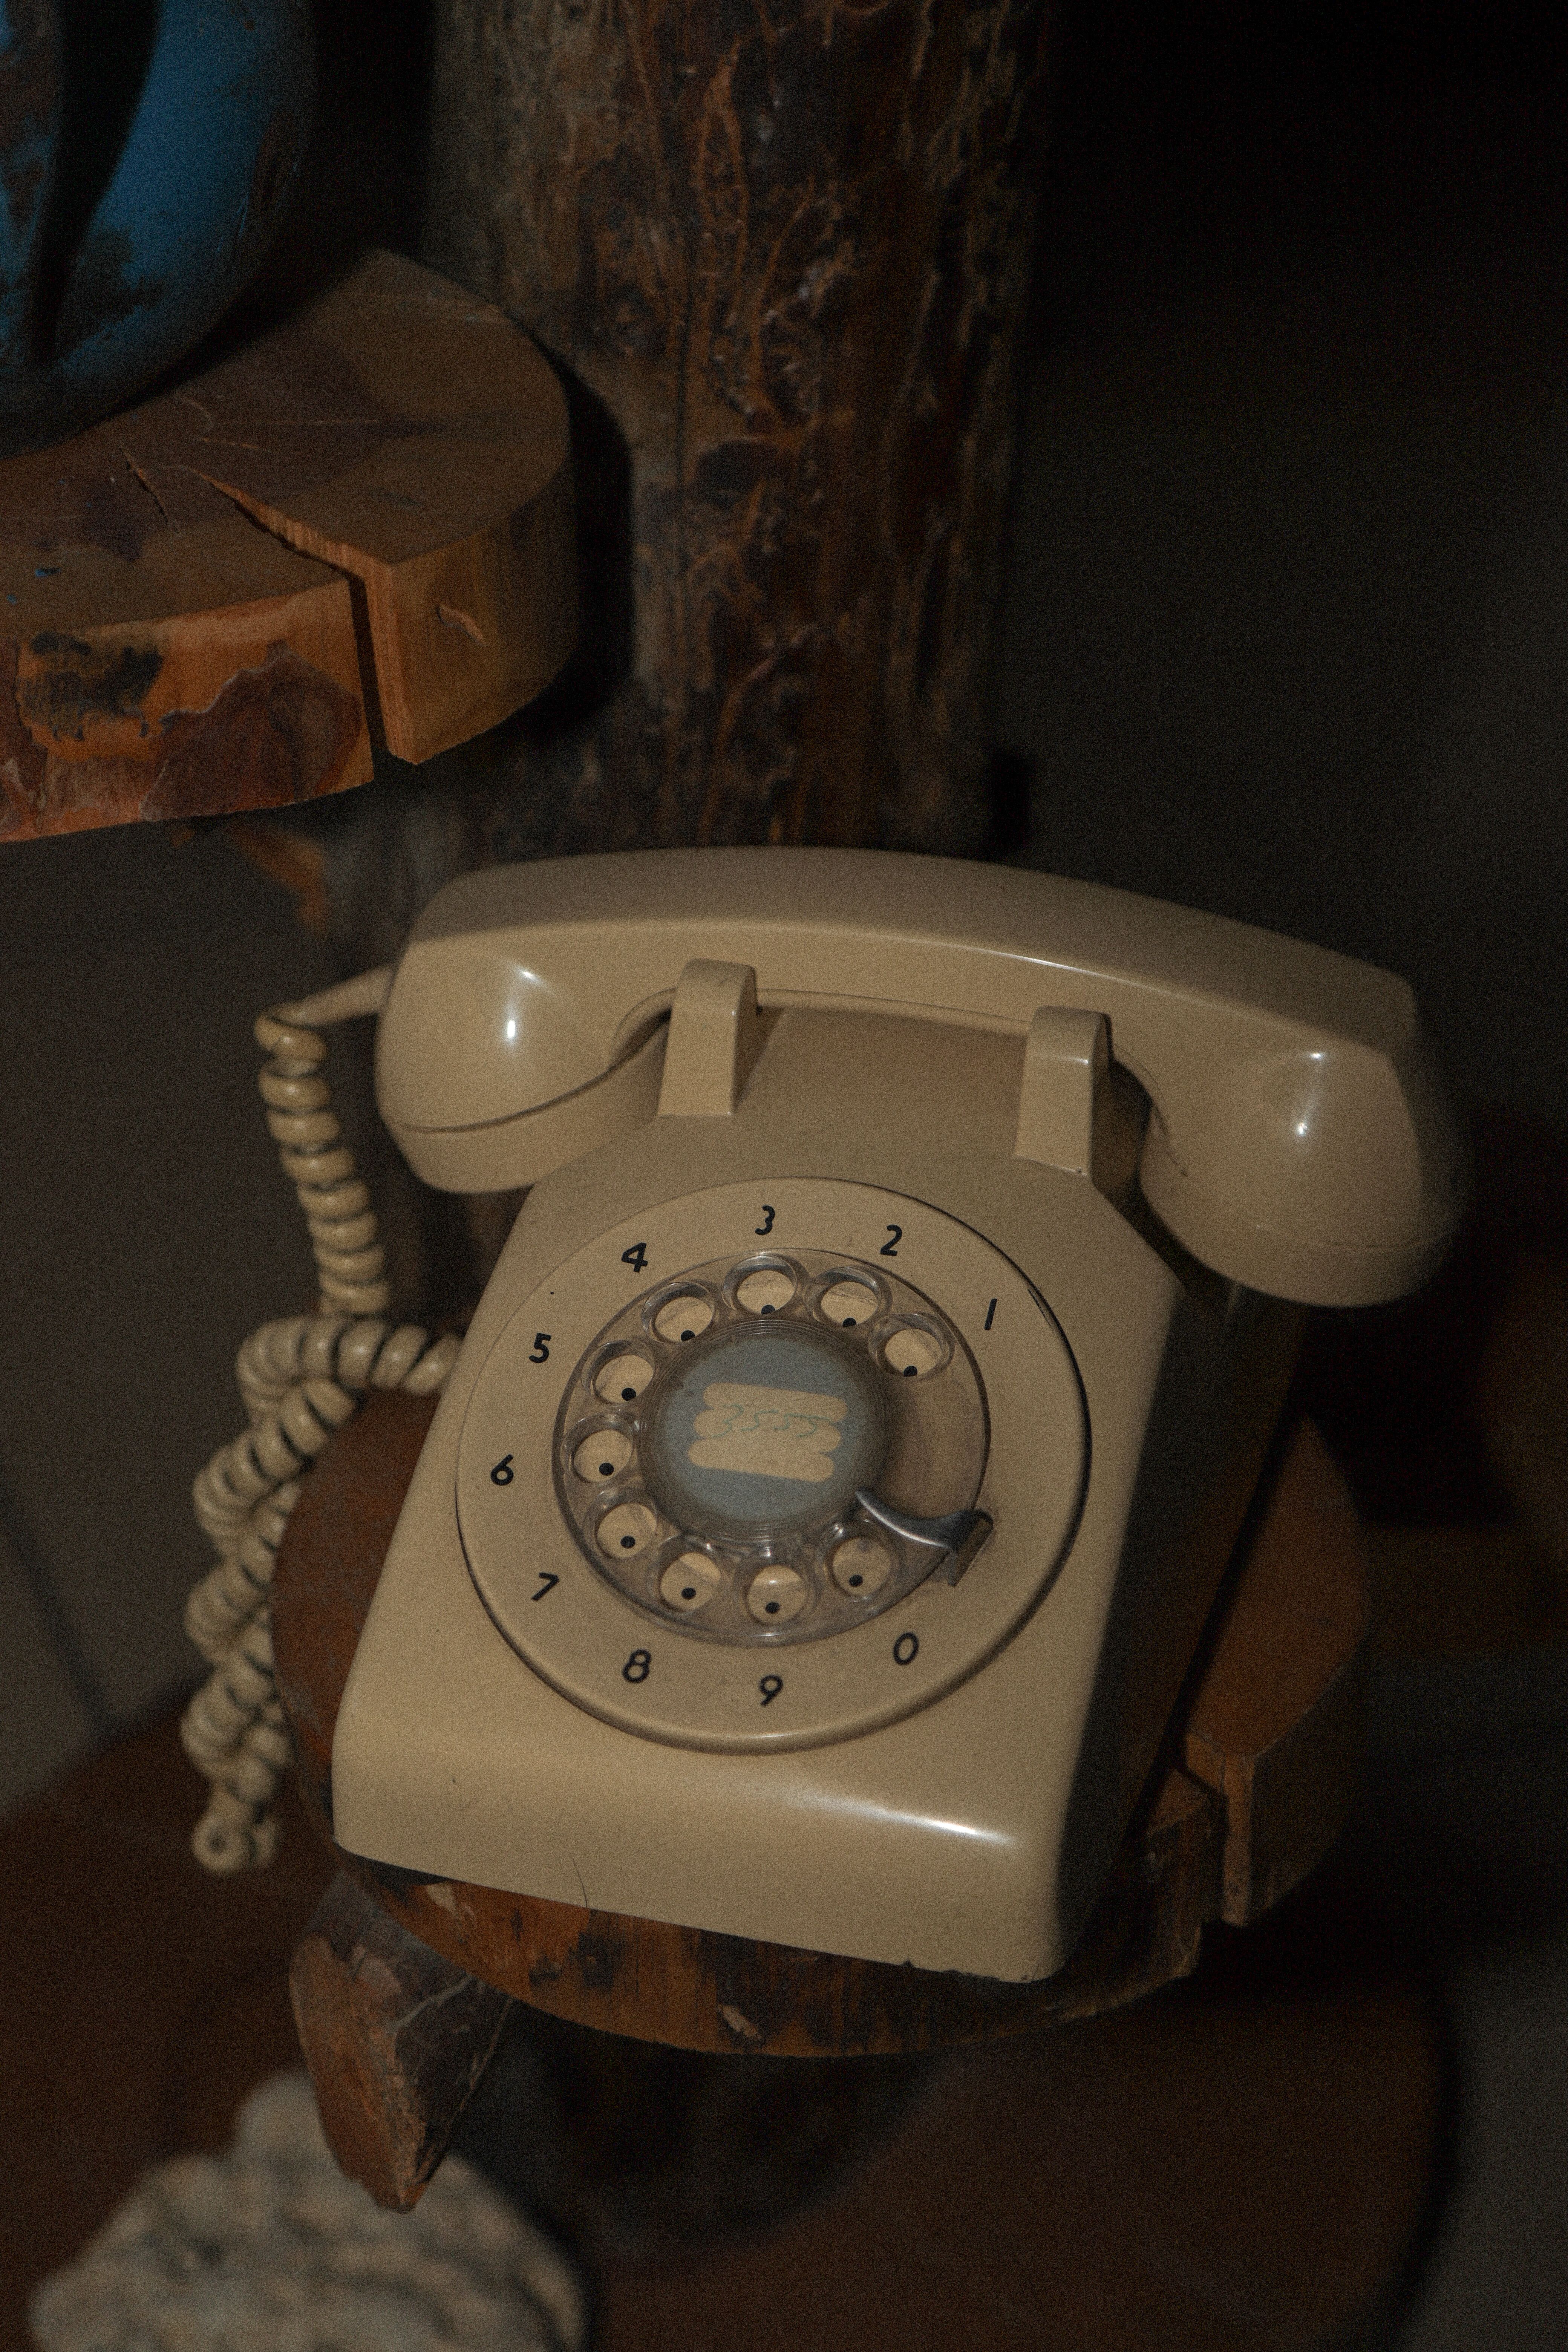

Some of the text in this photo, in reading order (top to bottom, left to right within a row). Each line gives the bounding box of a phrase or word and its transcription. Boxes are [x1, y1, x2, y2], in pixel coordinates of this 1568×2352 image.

[755, 1205, 775, 1236] 3
[880, 1225, 902, 1257] 2
[621, 1243, 648, 1273] 4
[985, 1298, 997, 1331] 1
[529, 1333, 551, 1364] 5
[490, 1455, 514, 1486] 6
[532, 1573, 559, 1601] 7
[893, 1632, 919, 1666] 0
[622, 1649, 652, 1684] 8
[759, 1675, 784, 1707] 9
